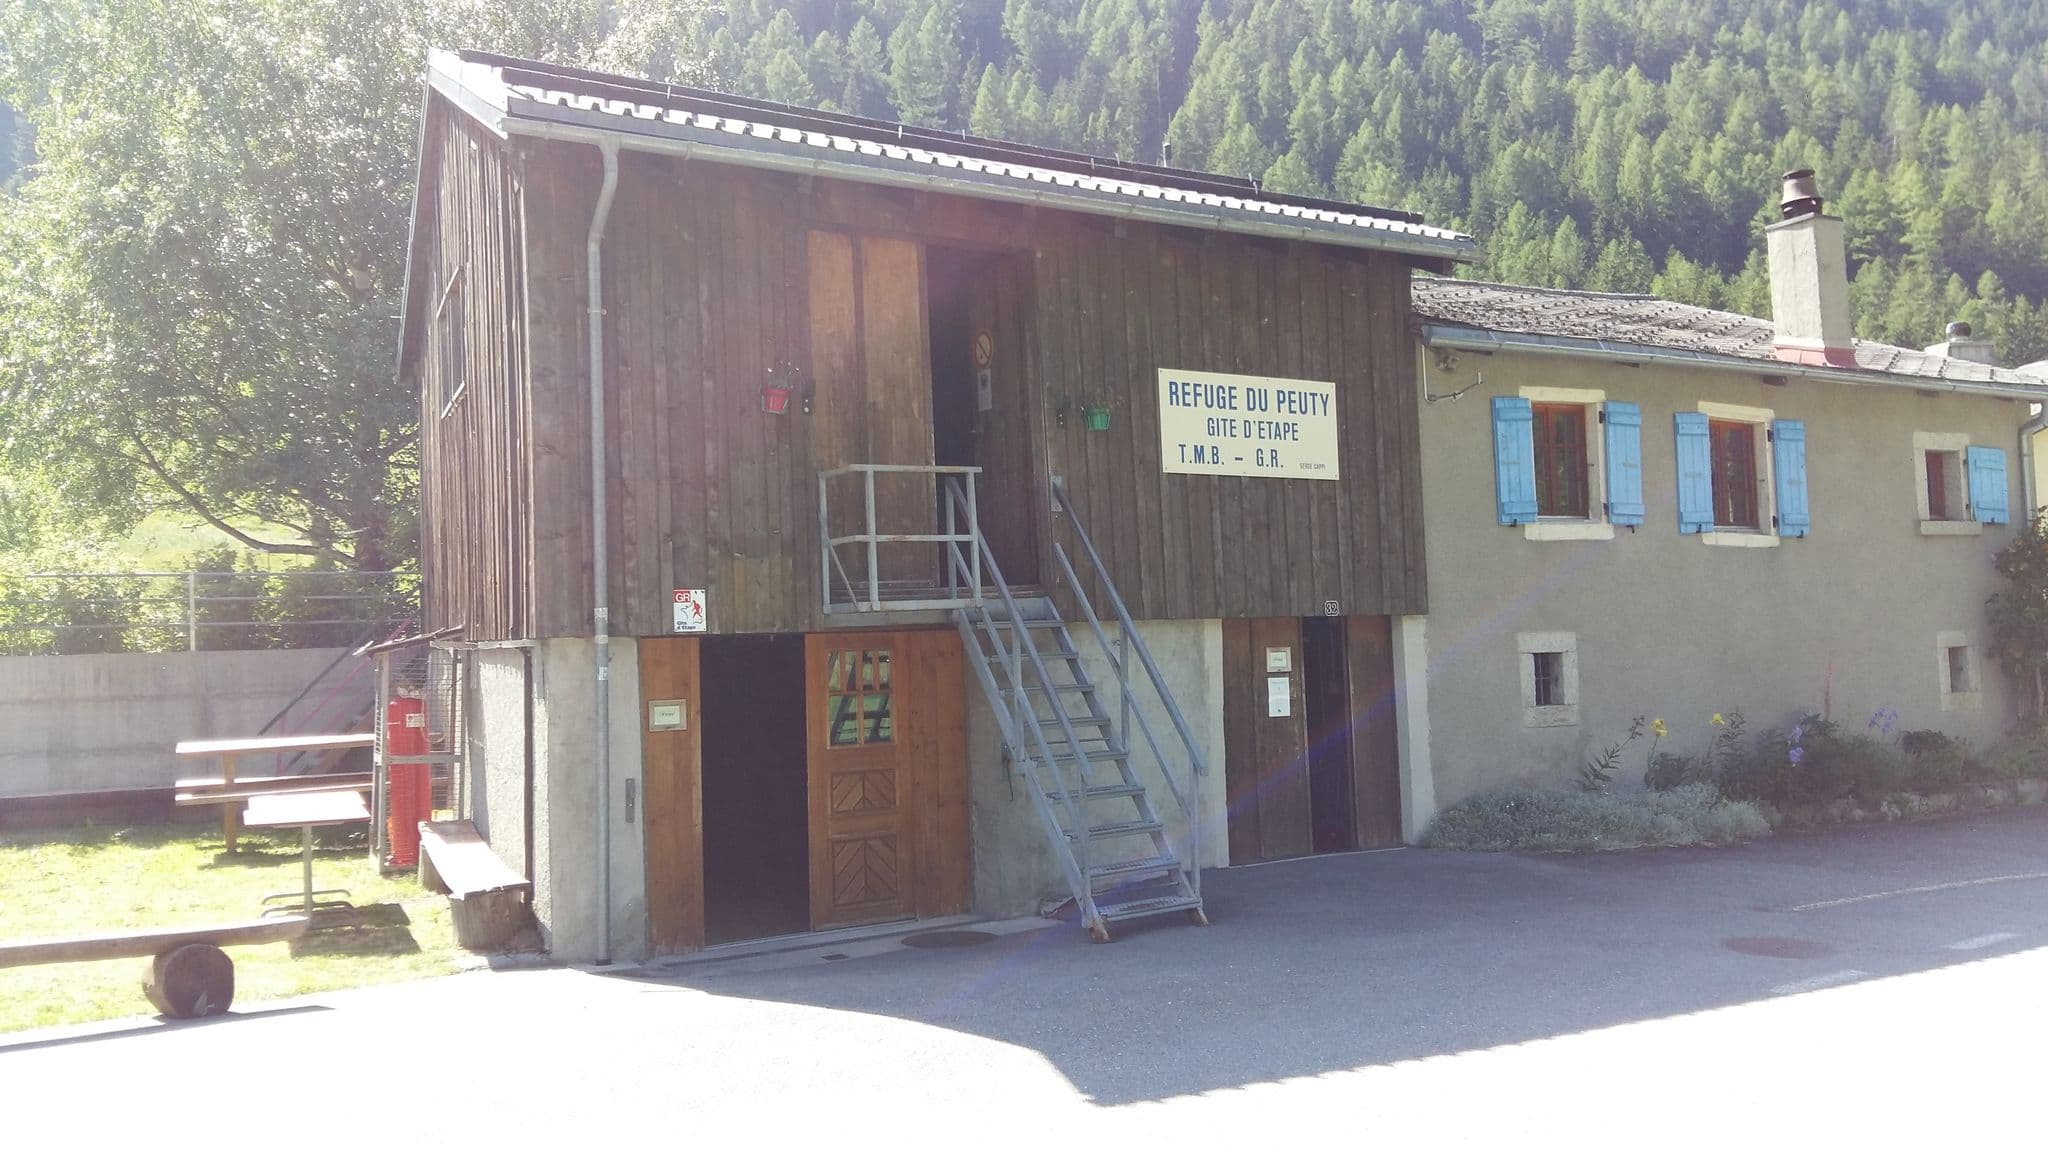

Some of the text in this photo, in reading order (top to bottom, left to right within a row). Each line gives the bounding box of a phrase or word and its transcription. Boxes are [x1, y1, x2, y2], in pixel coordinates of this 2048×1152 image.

[1168, 381, 1330, 417] REFUGE DU PEUTY
[1207, 417, 1299, 441] GITE D'ETAPE
[1178, 444, 1225, 465] T.M.B.
[1256, 448, 1284, 468] G.R.
[675, 592, 690, 602] GR
